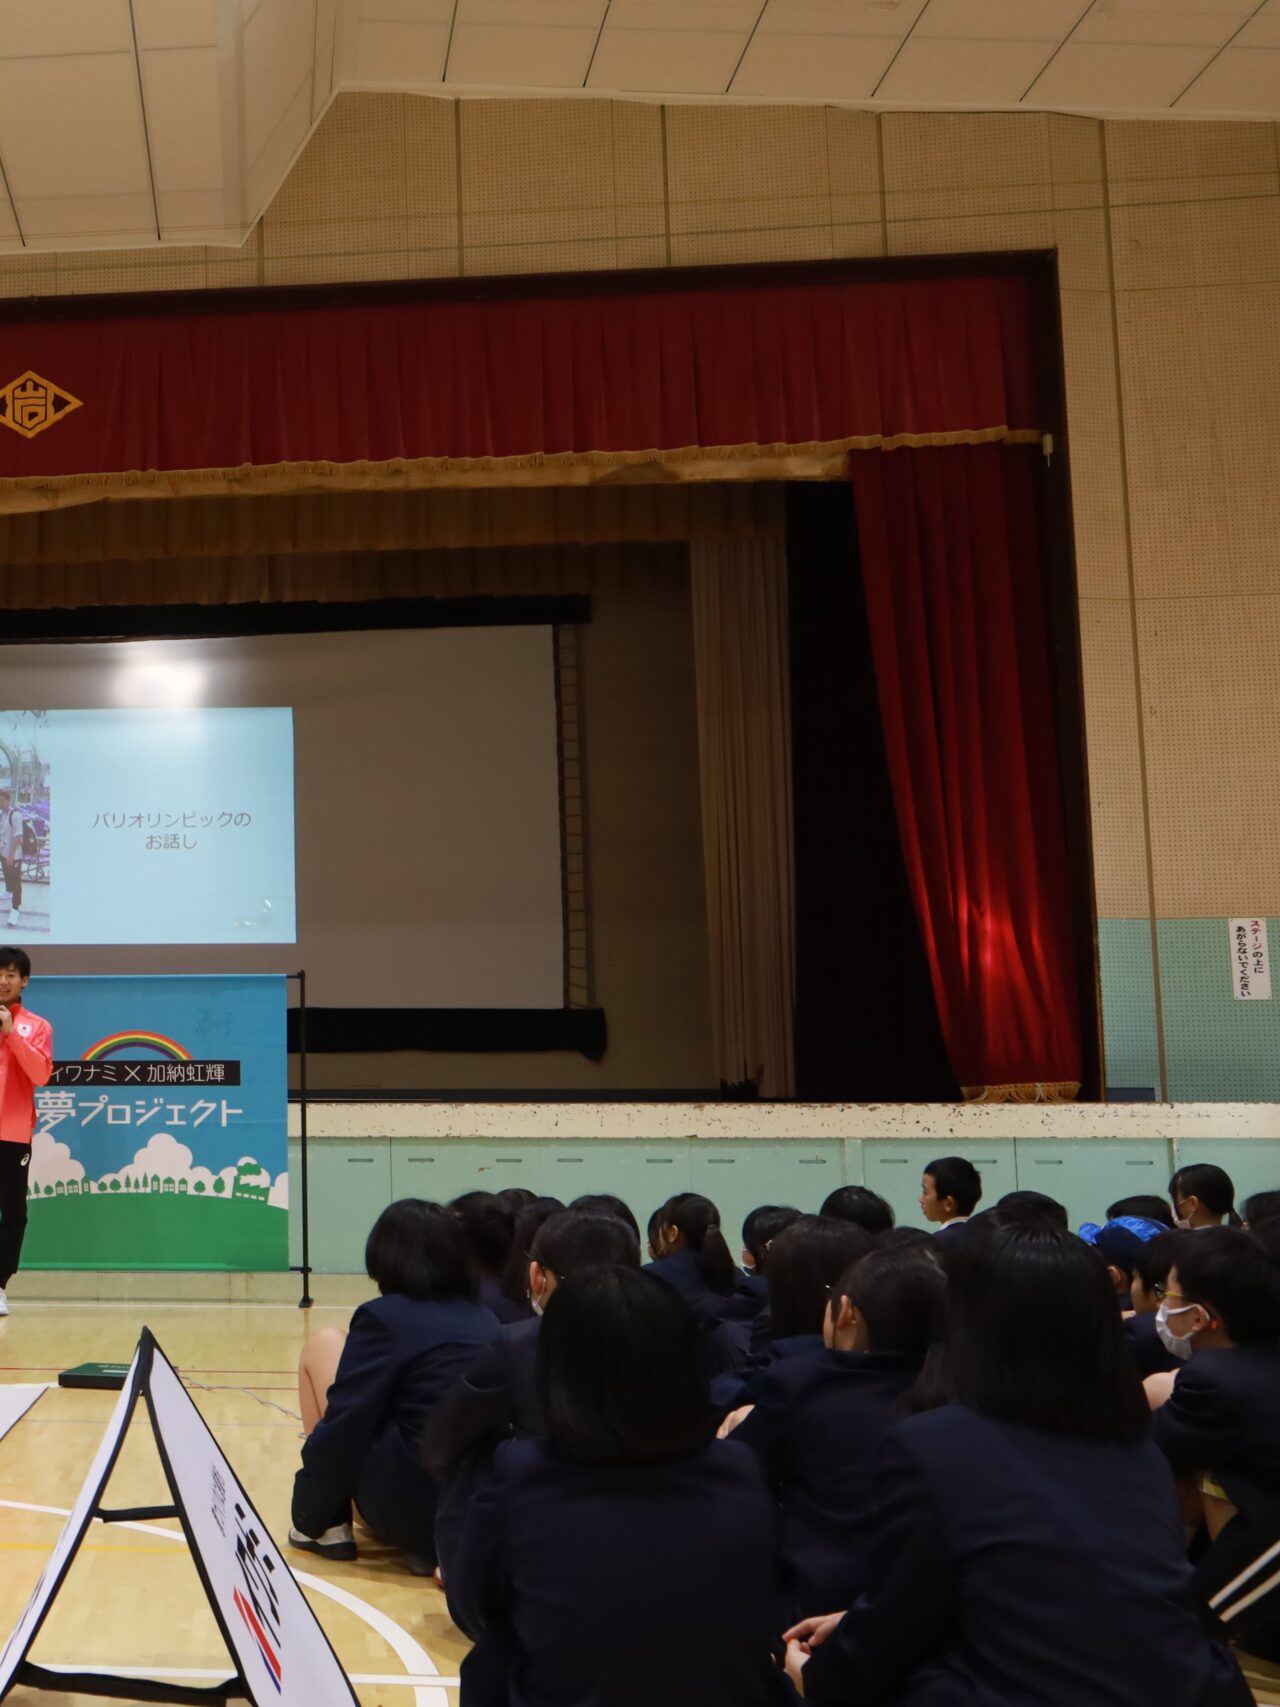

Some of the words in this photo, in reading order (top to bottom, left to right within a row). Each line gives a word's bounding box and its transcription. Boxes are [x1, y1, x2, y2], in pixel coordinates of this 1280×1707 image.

[92, 811, 252, 829] パリオリンピックの
[145, 833, 198, 850] お話し
[1235, 926, 1251, 997] あがらないでください
[1250, 920, 1265, 974] ステージの上に
[34, 1090, 243, 1133] 夢プロジェクト
